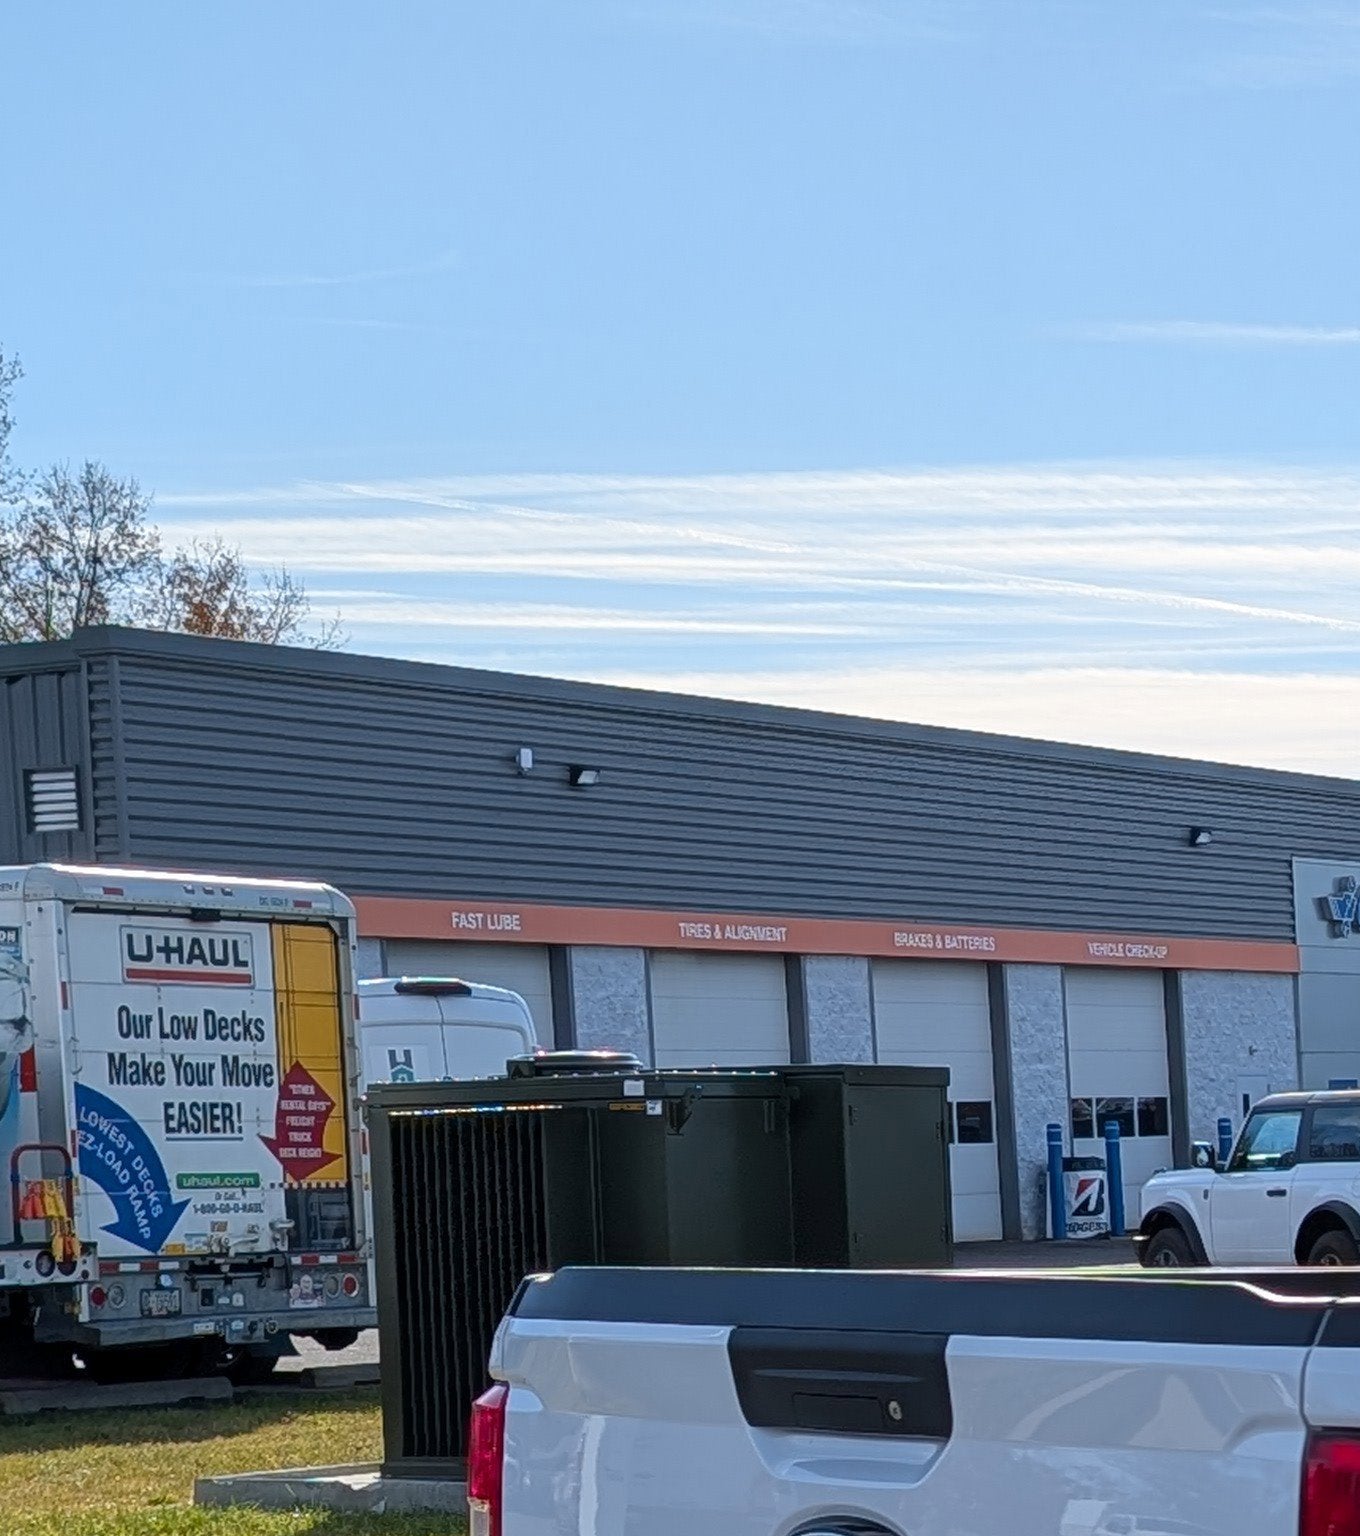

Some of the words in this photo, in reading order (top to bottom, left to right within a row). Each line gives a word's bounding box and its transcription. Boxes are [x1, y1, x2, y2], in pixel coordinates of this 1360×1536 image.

[452, 912, 483, 929] FAST
[487, 914, 521, 931] LUBE
[679, 922, 711, 939] TIRES
[724, 925, 787, 942] ALIGNMENT
[126, 934, 249, 967] U-HAUL
[894, 932, 934, 949] BRAKES
[945, 935, 996, 951] BATTERIES
[118, 1005, 153, 1039] Our
[158, 1007, 198, 1040] Low
[203, 1009, 265, 1042] Decks
[107, 1052, 166, 1086] Make
[171, 1054, 215, 1087] Your
[221, 1055, 274, 1088] Move
[163, 1102, 243, 1134] EASIER!
[79, 1106, 134, 1156] LOWEST
[132, 1156, 163, 1218] DECKS
[77, 1130, 130, 1185] EZ-LOAD
[126, 1185, 150, 1239] RAMP
[183, 1176, 255, 1187] uhaul.com
